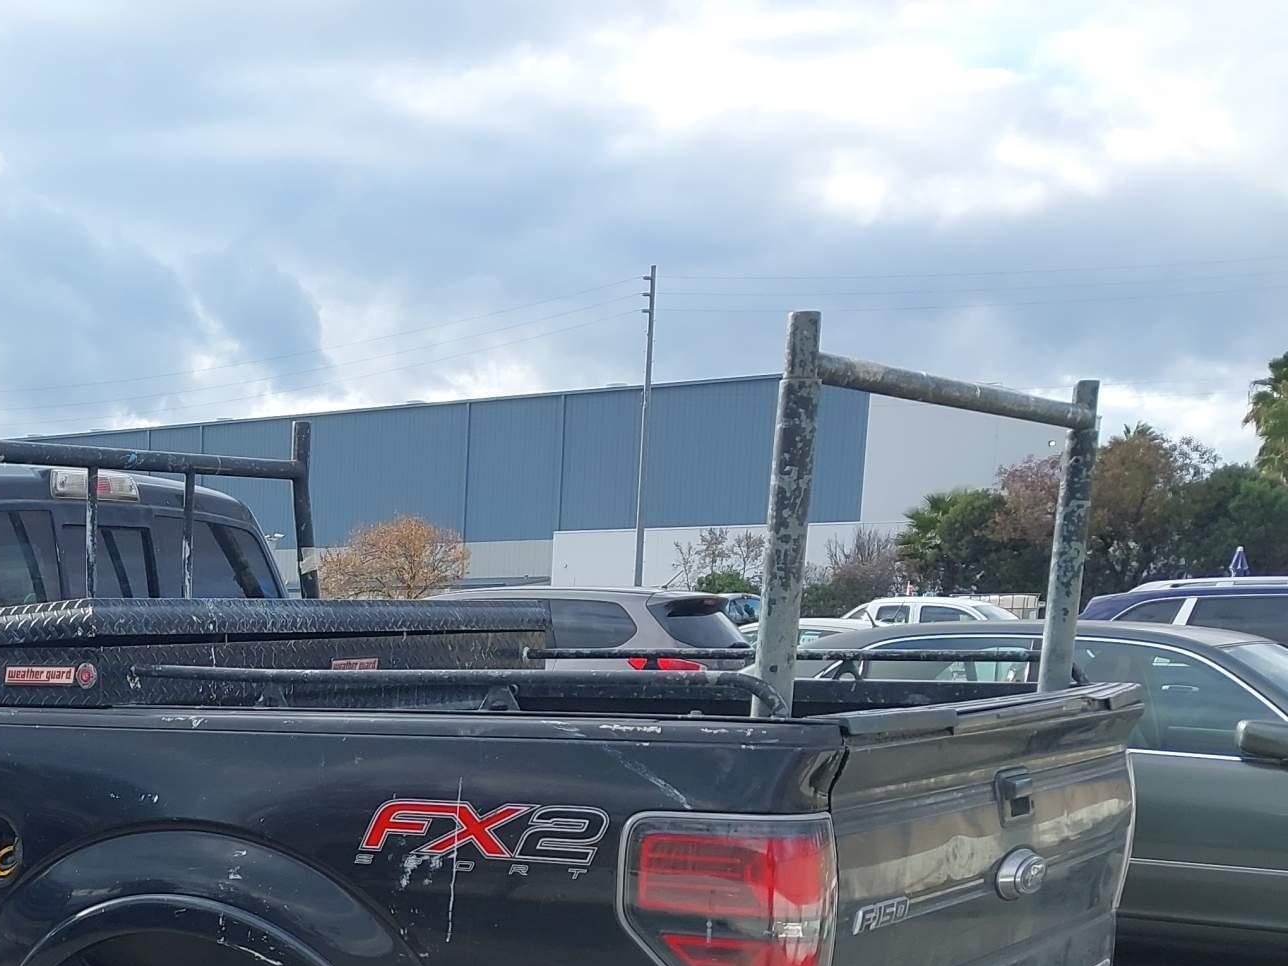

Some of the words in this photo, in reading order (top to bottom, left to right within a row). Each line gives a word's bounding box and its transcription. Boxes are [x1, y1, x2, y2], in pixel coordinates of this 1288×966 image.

[7, 668, 44, 680] weather
[45, 668, 73, 680] guard
[359, 799, 610, 865] FX2
